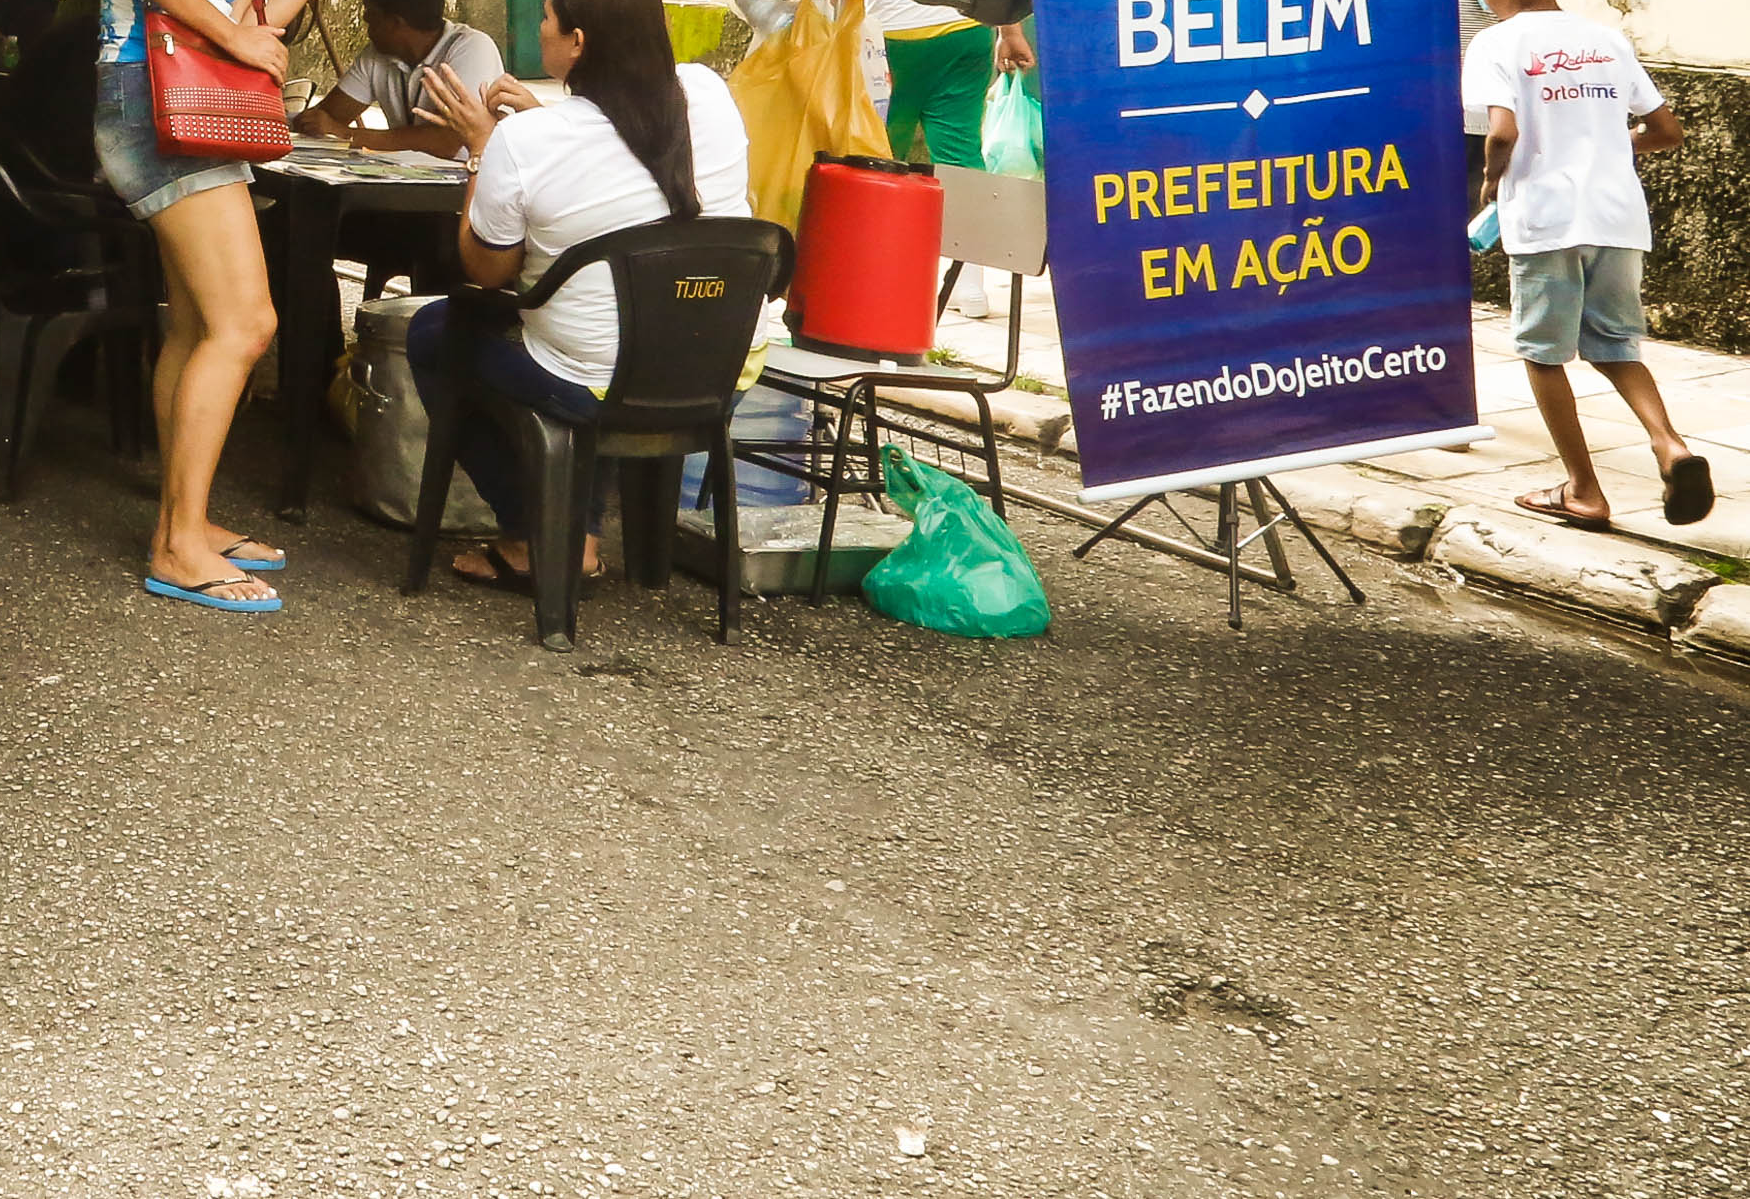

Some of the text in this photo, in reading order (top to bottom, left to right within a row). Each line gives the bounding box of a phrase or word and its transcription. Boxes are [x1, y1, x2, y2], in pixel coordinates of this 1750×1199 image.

[1094, 144, 1410, 224] PREFEITURA
[675, 280, 725, 299] TIJUCA
[1141, 216, 1372, 299] EM AÇÃO
[1100, 343, 1447, 420] #FazendoDoJeitoCerto
